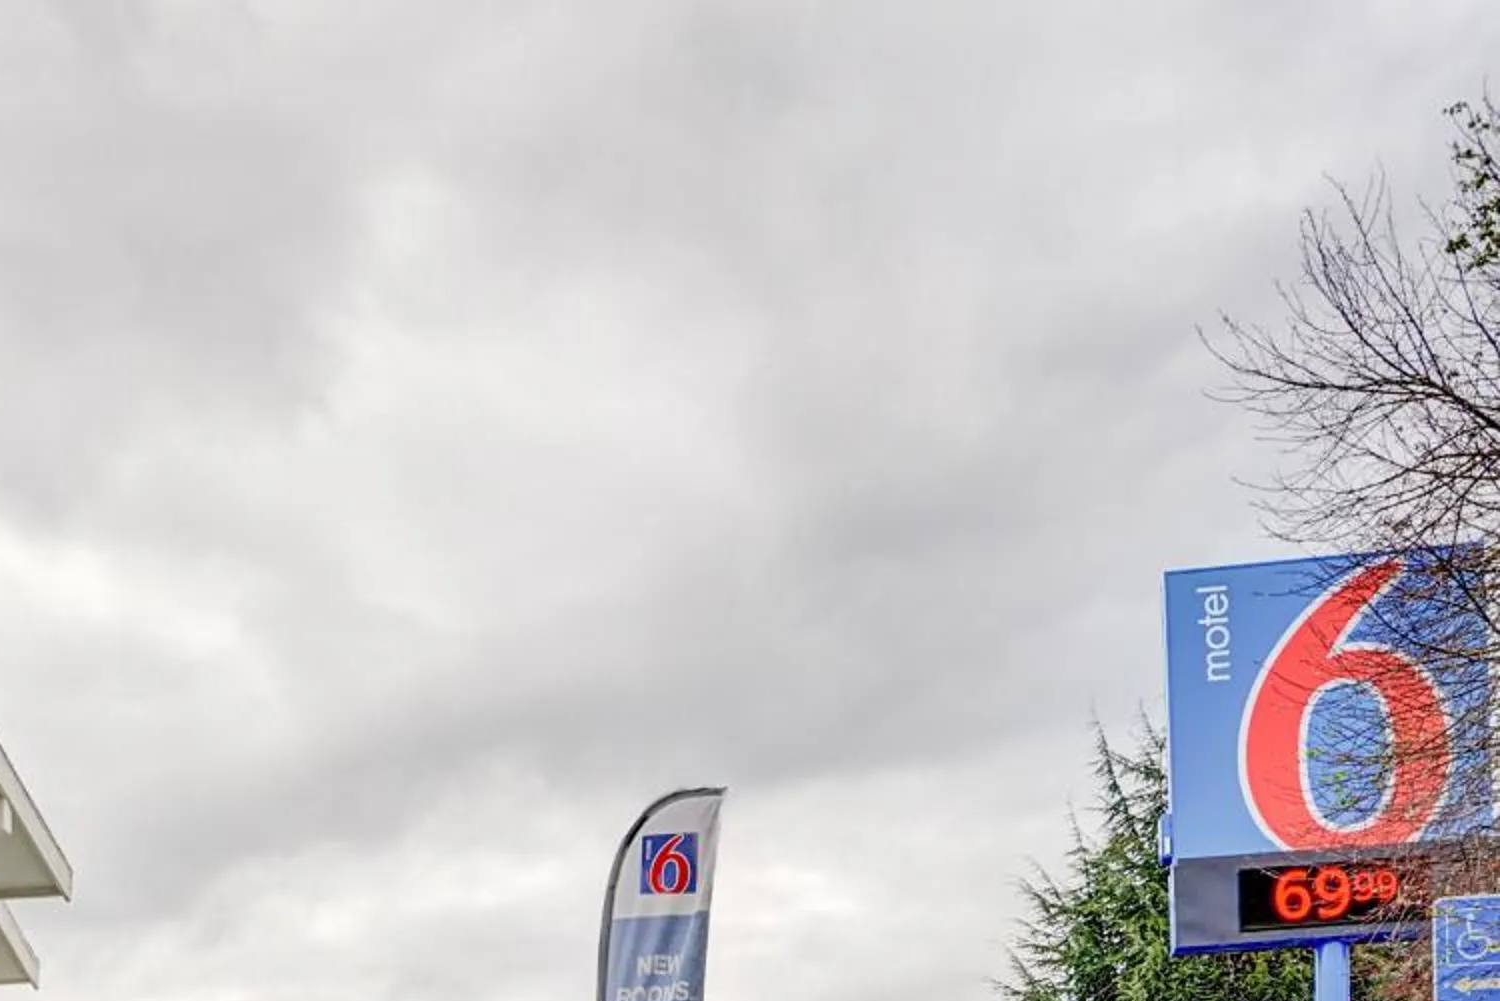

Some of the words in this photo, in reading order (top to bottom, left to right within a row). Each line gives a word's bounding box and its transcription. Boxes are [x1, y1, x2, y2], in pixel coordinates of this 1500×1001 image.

[1196, 584, 1232, 683] motel
[1238, 557, 1451, 855] 6
[649, 833, 691, 895] 6
